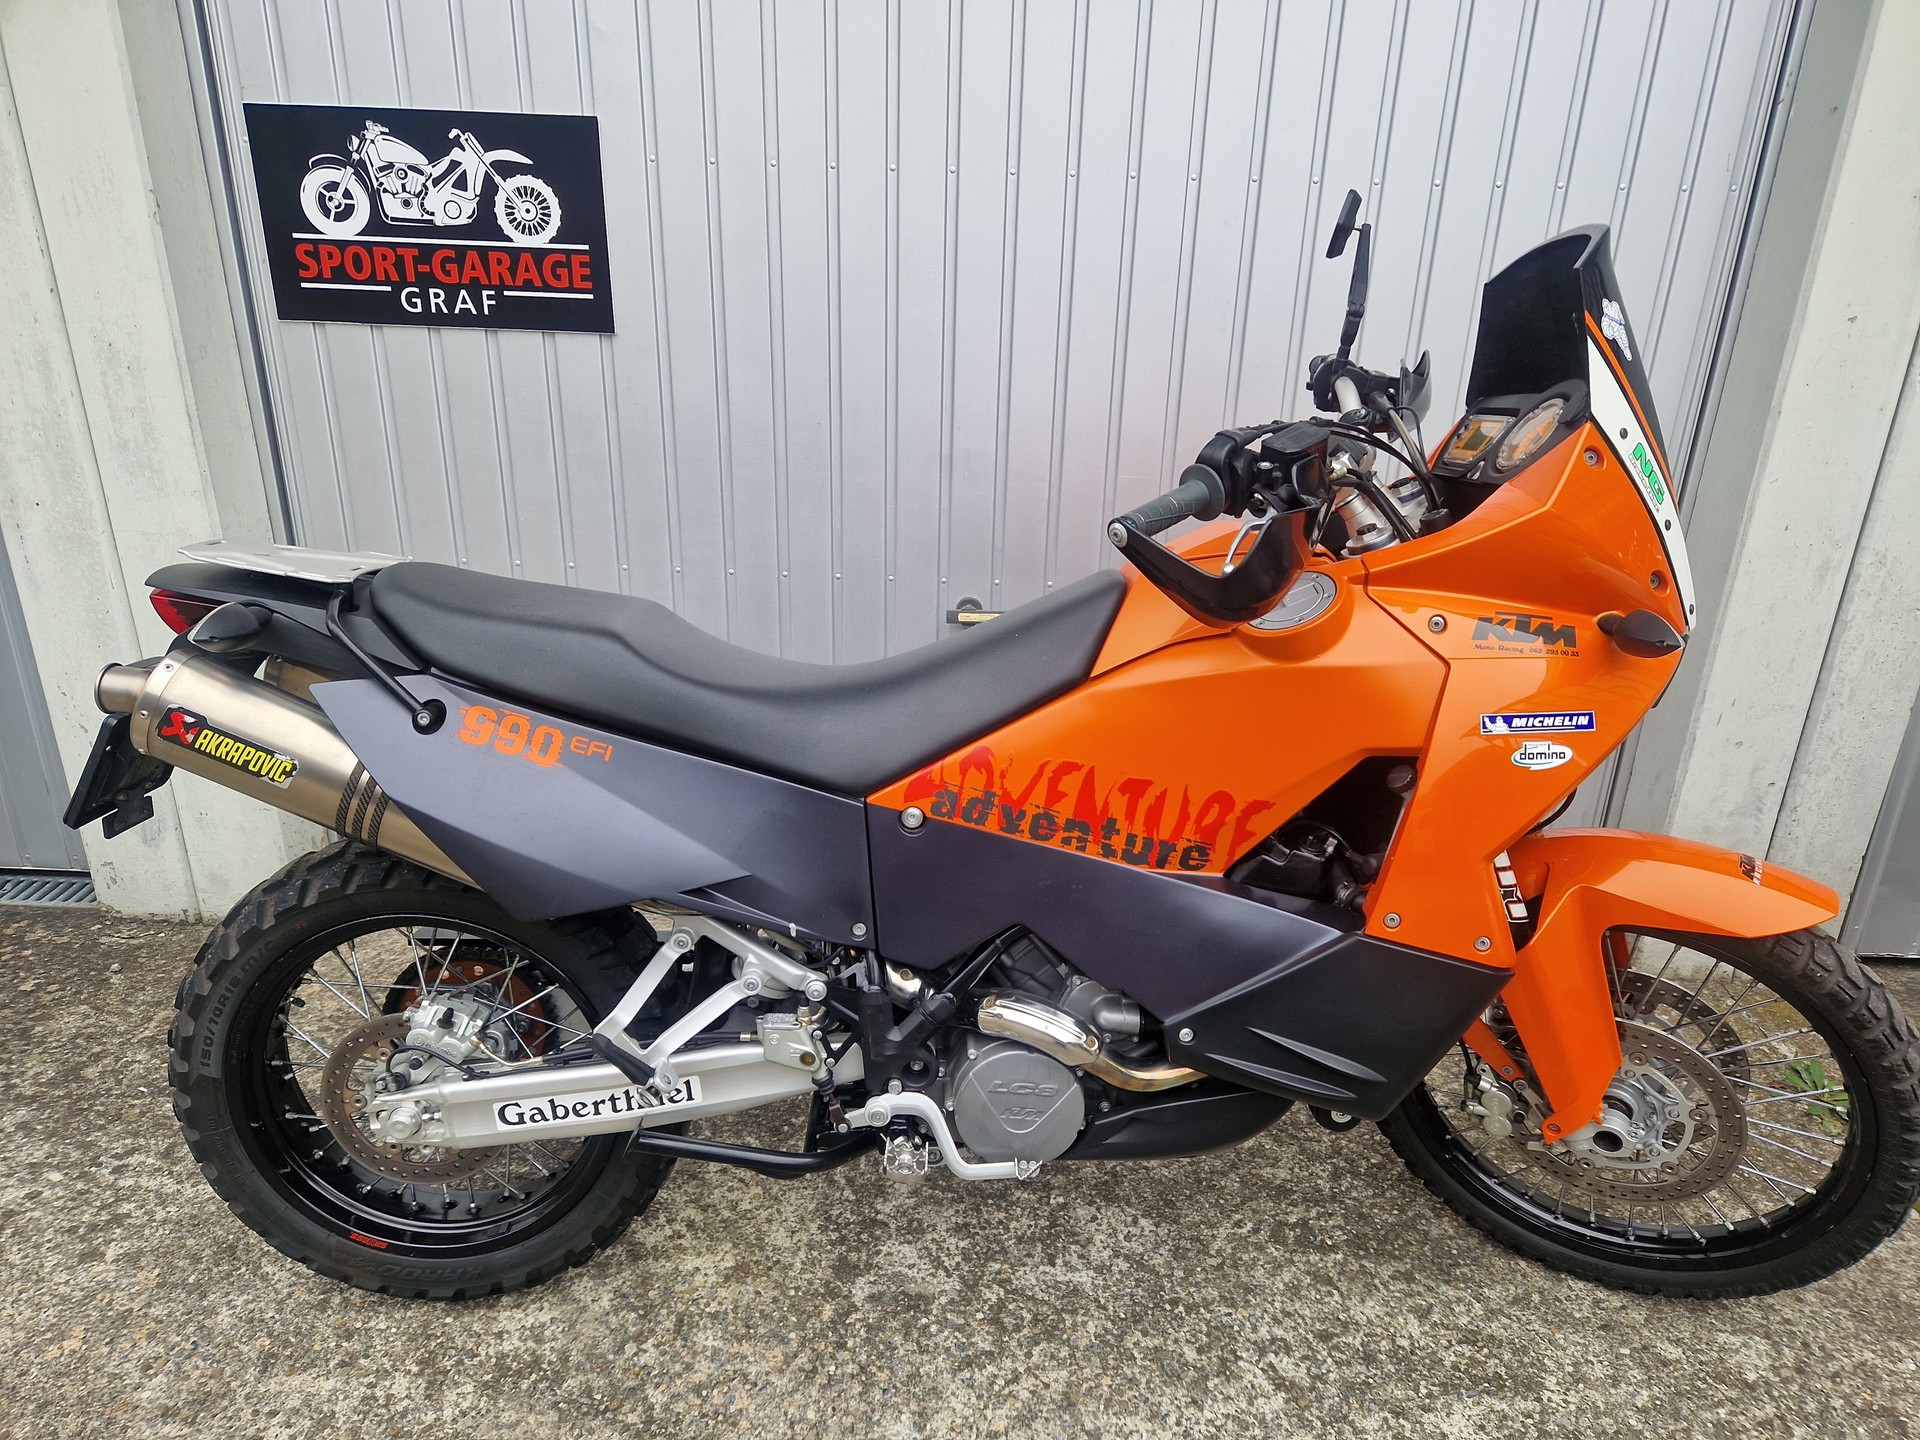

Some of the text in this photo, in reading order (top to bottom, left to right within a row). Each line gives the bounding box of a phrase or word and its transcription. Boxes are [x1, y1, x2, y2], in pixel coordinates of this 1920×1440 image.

[295, 243, 593, 289] SPORT-GARAGE
[400, 286, 496, 315] GRAF
[1632, 442, 1665, 505] NG
[1472, 611, 1577, 648] KTM
[455, 704, 614, 768] 990 EFI
[1511, 715, 1589, 728] MICHELIN
[1519, 743, 1566, 760] domino
[930, 781, 1213, 871] adventure
